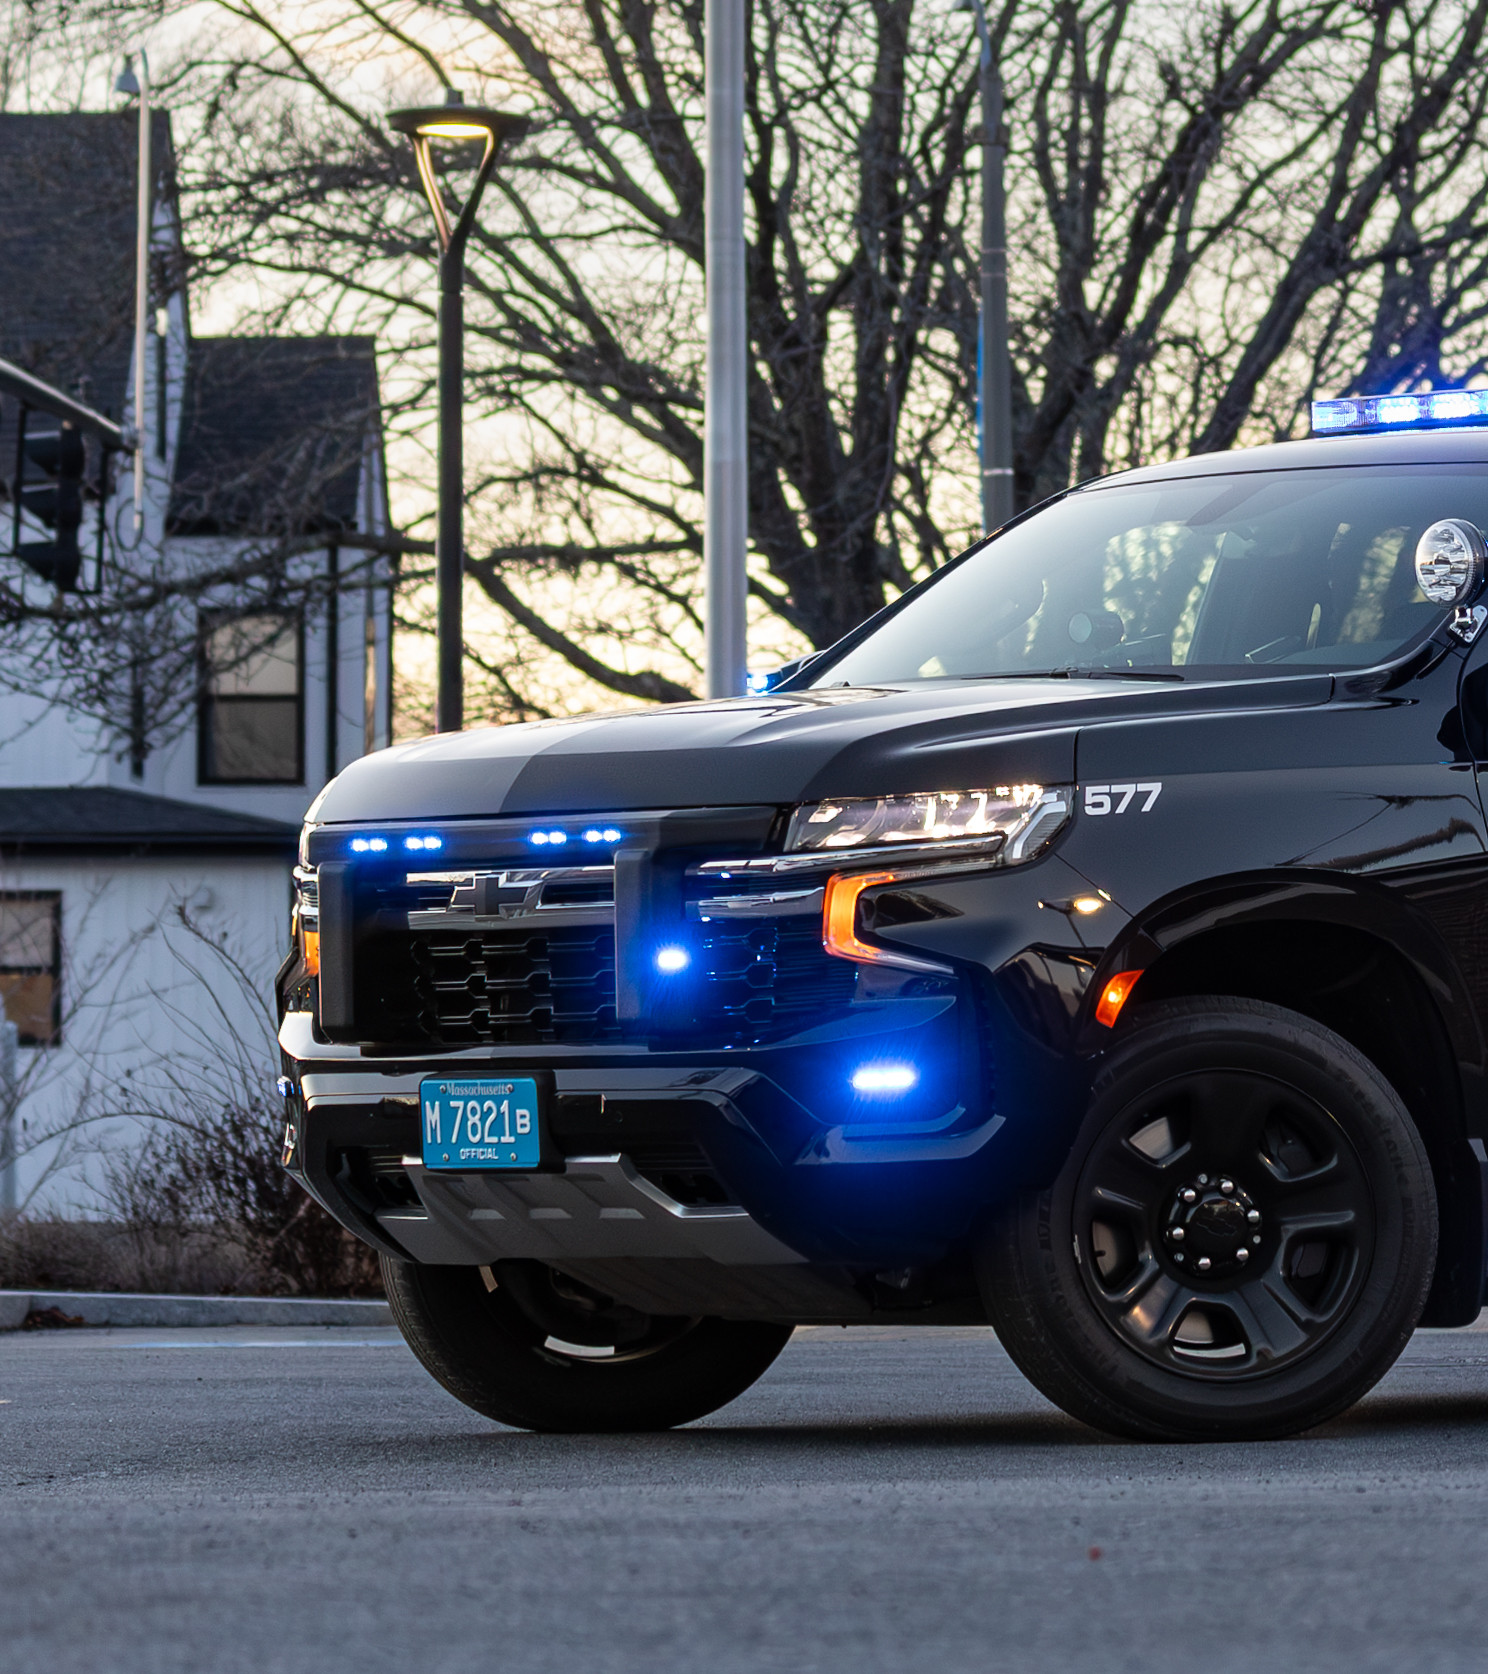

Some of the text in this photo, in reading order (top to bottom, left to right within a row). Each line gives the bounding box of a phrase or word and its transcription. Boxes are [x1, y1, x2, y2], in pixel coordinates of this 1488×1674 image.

[1084, 782, 1163, 816] 577
[447, 1083, 510, 1096] Massachusetts
[460, 1148, 499, 1160] OFFICIAL
